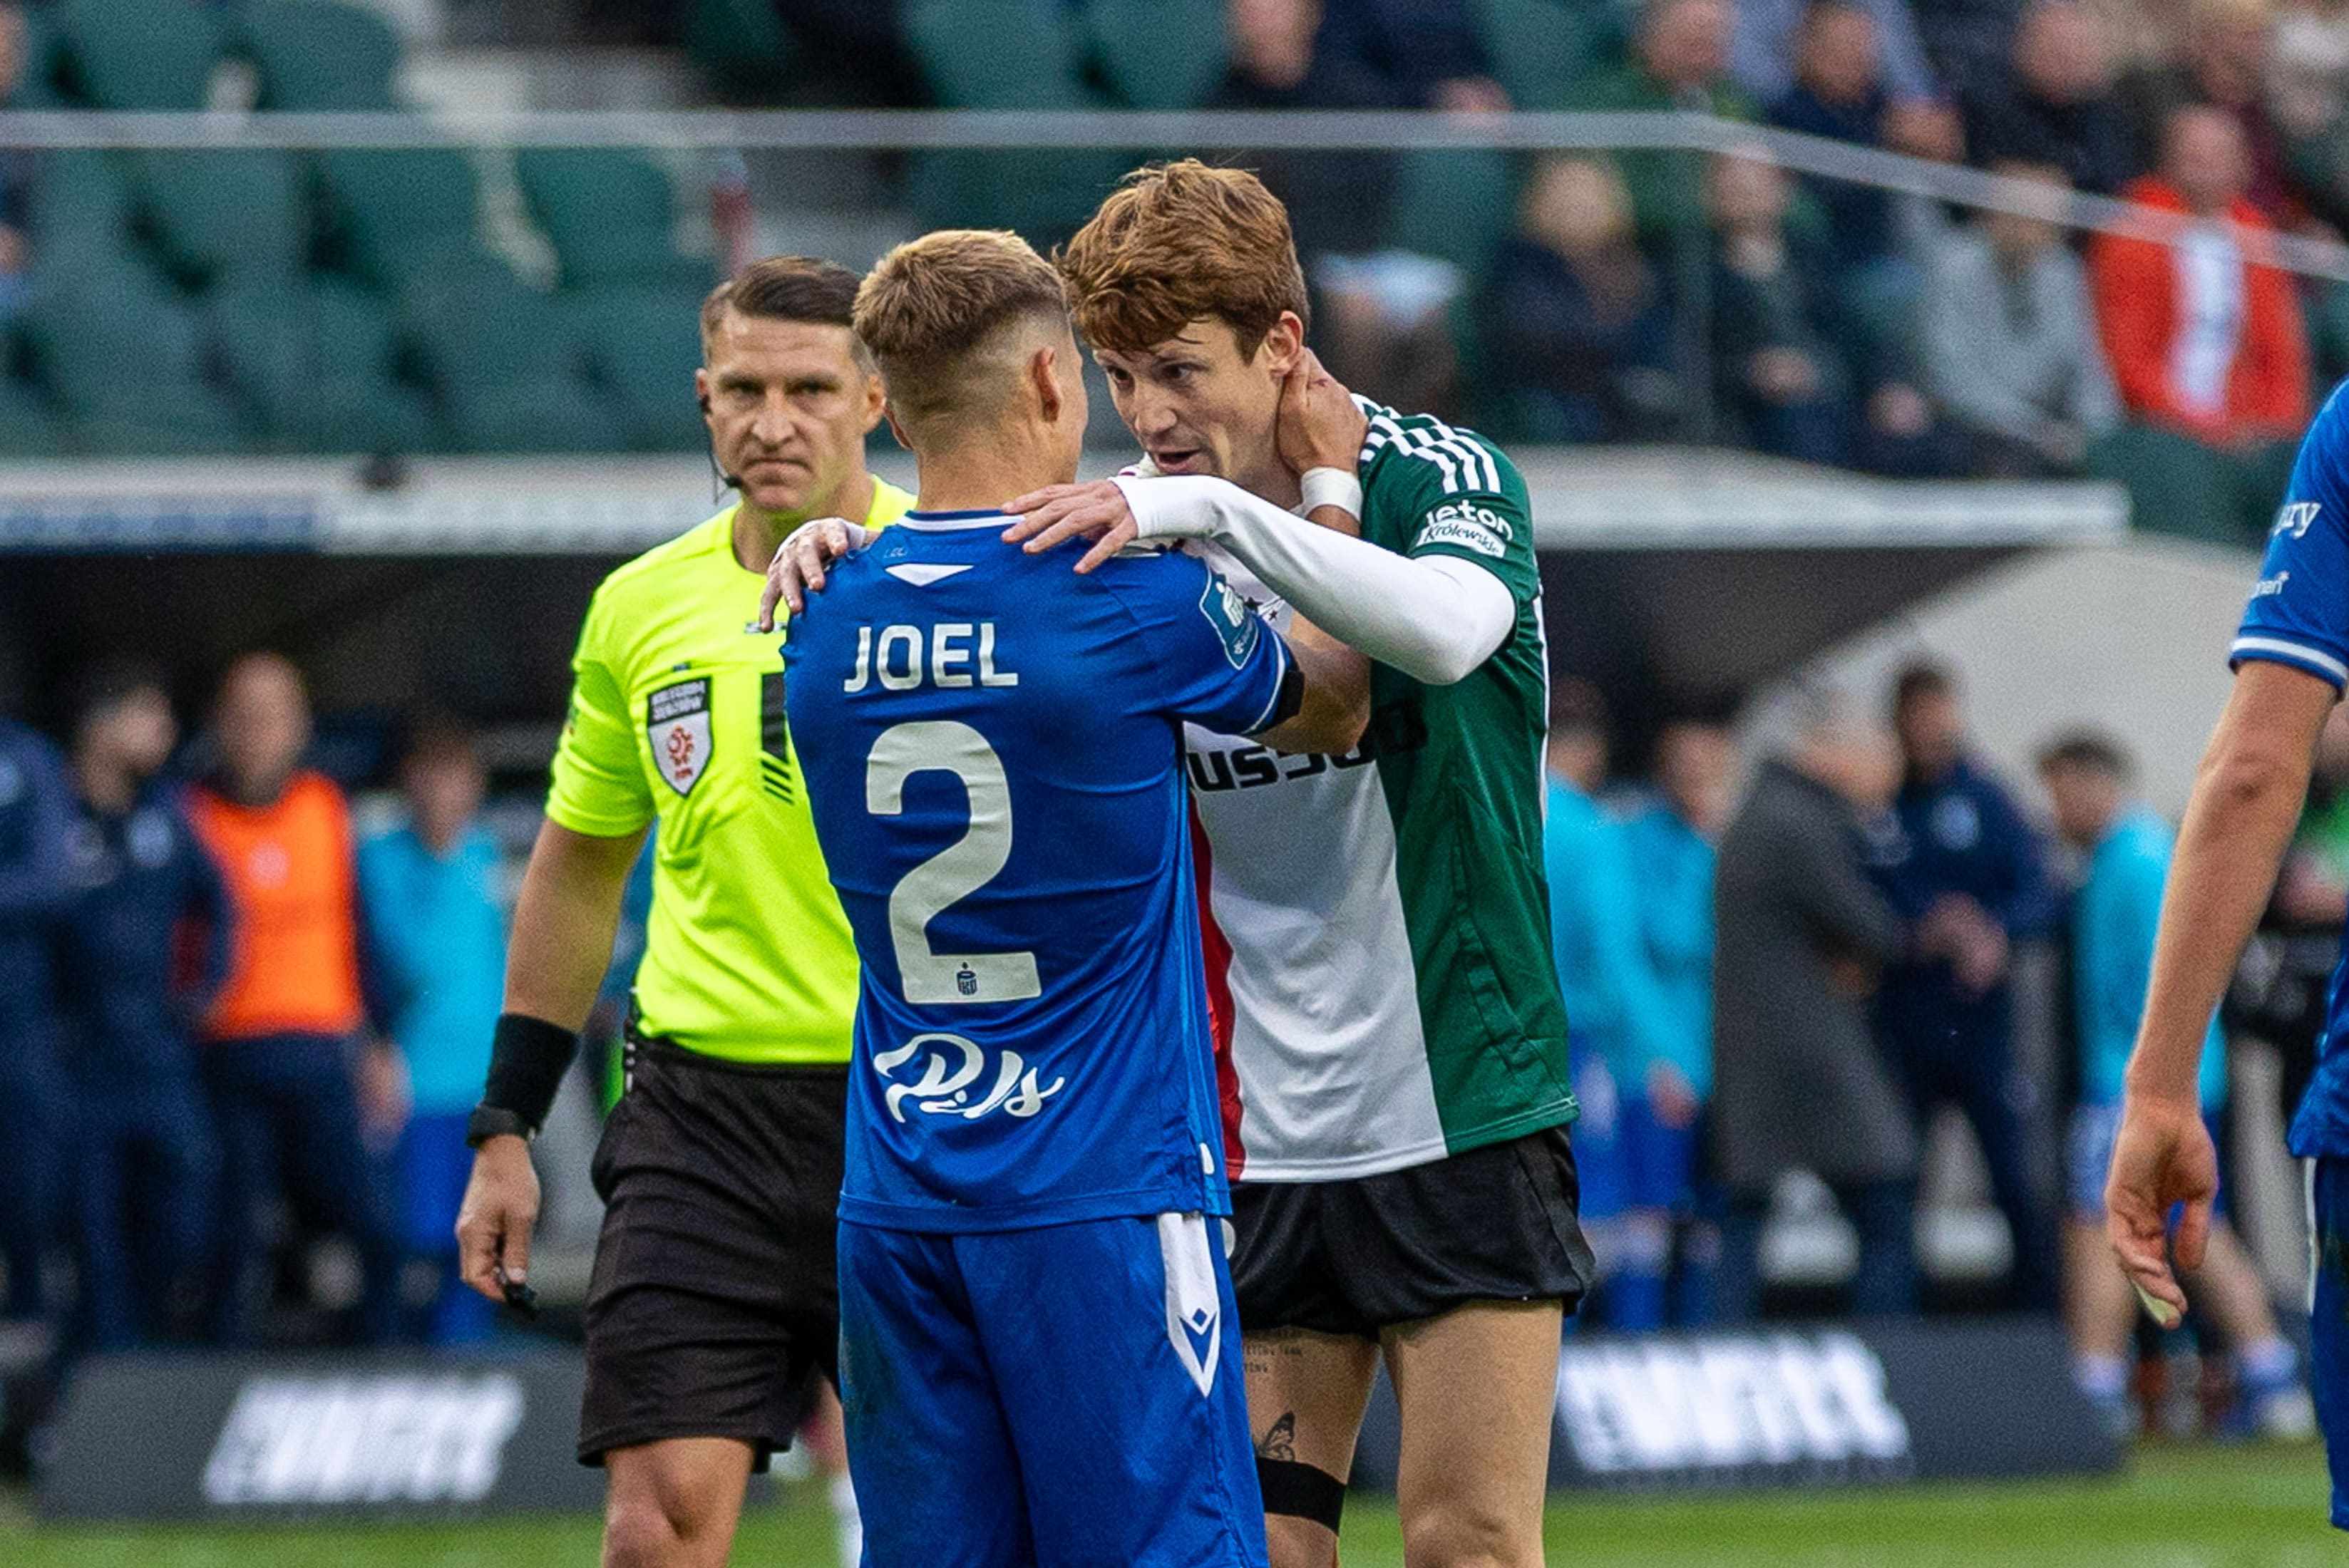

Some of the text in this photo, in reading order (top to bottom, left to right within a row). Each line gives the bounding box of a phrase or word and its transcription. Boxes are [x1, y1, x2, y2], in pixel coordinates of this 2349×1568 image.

[843, 622, 1019, 693] JOEL
[865, 720, 1042, 1005] 2
[873, 1033, 1065, 1123] Pils
